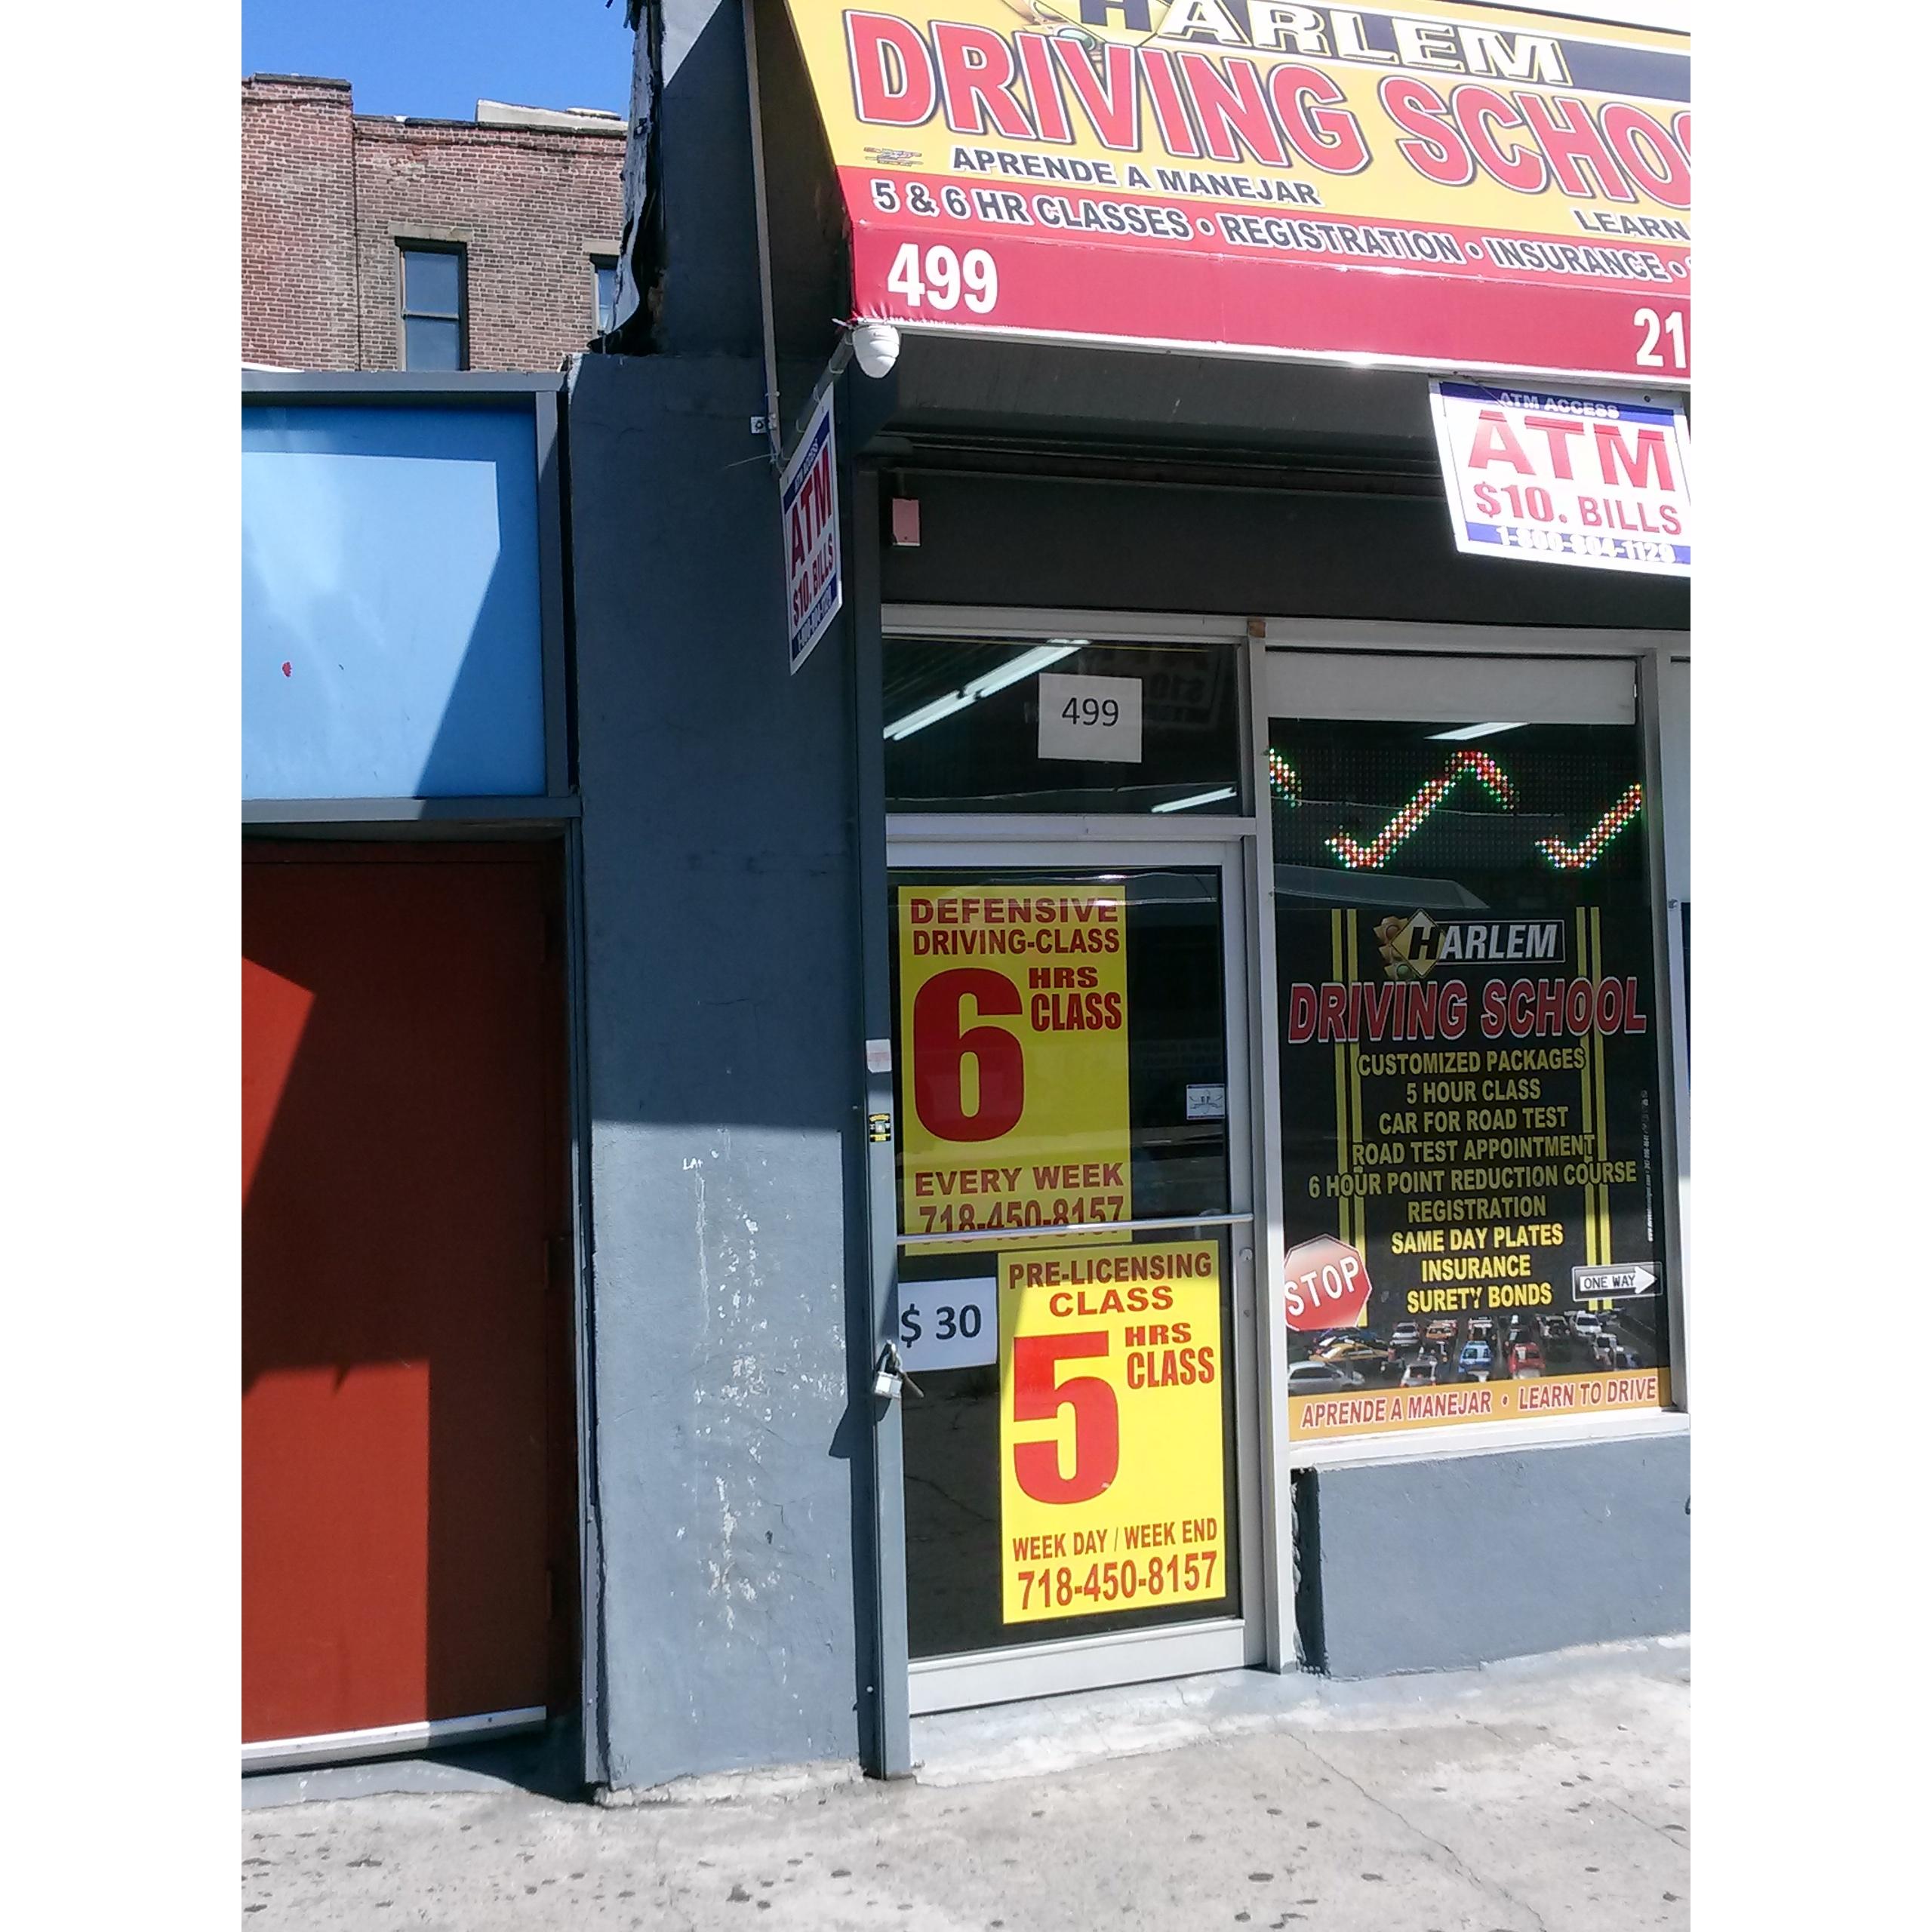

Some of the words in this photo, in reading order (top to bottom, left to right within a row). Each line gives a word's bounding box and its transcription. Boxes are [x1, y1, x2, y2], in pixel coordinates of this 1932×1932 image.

[844, 9, 1372, 175] DRIVING
[1379, 75, 1690, 211] SCHO
[952, 147, 1118, 186] APRENDE
[1126, 158, 1150, 189] A
[1156, 168, 1321, 205] MANEJAR
[874, 180, 897, 211] 5
[911, 185, 935, 214] &
[946, 186, 968, 217] 6
[975, 190, 1029, 225] HR
[1035, 195, 1190, 240] CLASSES
[1223, 214, 1464, 263] REGISTRATION
[1487, 238, 1669, 281] INSURANCE
[1573, 209, 1690, 241] LEARN
[888, 242, 999, 314] 499
[1499, 392, 1540, 410] ATM
[1543, 398, 1620, 420] ACCESS
[1468, 409, 1676, 491] ATM
[792, 444, 832, 581] ATM
[1473, 481, 1568, 524] $10.
[1577, 495, 1683, 536] BILLS
[812, 532, 833, 596] BILLS
[1061, 697, 1119, 727] 499
[910, 897, 1119, 924] DEFENSIVE
[912, 928, 1120, 955] DRIVING-CLASS
[1408, 924, 1558, 961] HARLEM
[1031, 992, 1122, 1032] CLASS
[1287, 979, 1468, 1044] DRIVING
[1481, 977, 1647, 1039] SCHOOL
[912, 968, 1025, 1143] 6
[1028, 967, 1099, 989] HRS
[1358, 1051, 1481, 1078] CUSTOMIZED
[1486, 1045, 1586, 1072] PACKAGES
[1405, 1082, 1417, 1104] 5
[1423, 1080, 1477, 1104] HOUR
[1481, 1078, 1541, 1102] CLASS
[1379, 1111, 1418, 1135] CAR
[1423, 1109, 1461, 1133] FOR
[1466, 1107, 1518, 1131] ROAD
[1521, 1106, 1569, 1129] TEST
[1352, 1142, 1405, 1166] ROAD
[1410, 1139, 1459, 1162] TEST
[1463, 1134, 1596, 1161] APPOINTMENT
[915, 1168, 1023, 1197] EVERY
[1032, 1162, 1124, 1190] WEEK
[1307, 1177, 1320, 1198] 6
[1326, 1173, 1381, 1198] HOUR
[1386, 1168, 1445, 1195] POINT
[1451, 1163, 1559, 1192] REDUCTION
[1563, 1160, 1638, 1187] COURSE
[1407, 1195, 1547, 1224] REGISTRATION
[1391, 1229, 1445, 1254] SAME
[1449, 1226, 1487, 1251] DAY
[1493, 1223, 1564, 1248] PLATES
[1009, 1251, 1213, 1289] PRE-LICENSING
[1283, 1254, 1361, 1318] STOP
[1421, 1254, 1531, 1283] INSURANCE
[1583, 1275, 1609, 1290] ONE
[1611, 1274, 1636, 1288] WAY
[1049, 1285, 1174, 1318] CLASS
[1407, 1287, 1481, 1314] SURETY
[1487, 1282, 1553, 1309] BONDS
[900, 1303, 922, 1349] $
[935, 1303, 982, 1341] 30
[1126, 1346, 1216, 1390] CLASS
[1013, 1330, 1120, 1506] 5
[1124, 1321, 1192, 1347] HRS
[1301, 1398, 1386, 1429] APRENDE
[1390, 1396, 1403, 1421] A
[1407, 1391, 1493, 1420] MANEJAR
[1518, 1383, 1574, 1411] LEARN
[1579, 1381, 1601, 1407] TO
[1604, 1377, 1658, 1404] DRIVE
[1012, 1532, 1066, 1563] WEEK
[1072, 1527, 1109, 1557] DAY
[1124, 1521, 1177, 1551] WEEK
[1182, 1517, 1218, 1544] END
[1017, 1550, 1218, 1611] 718-450-8157
